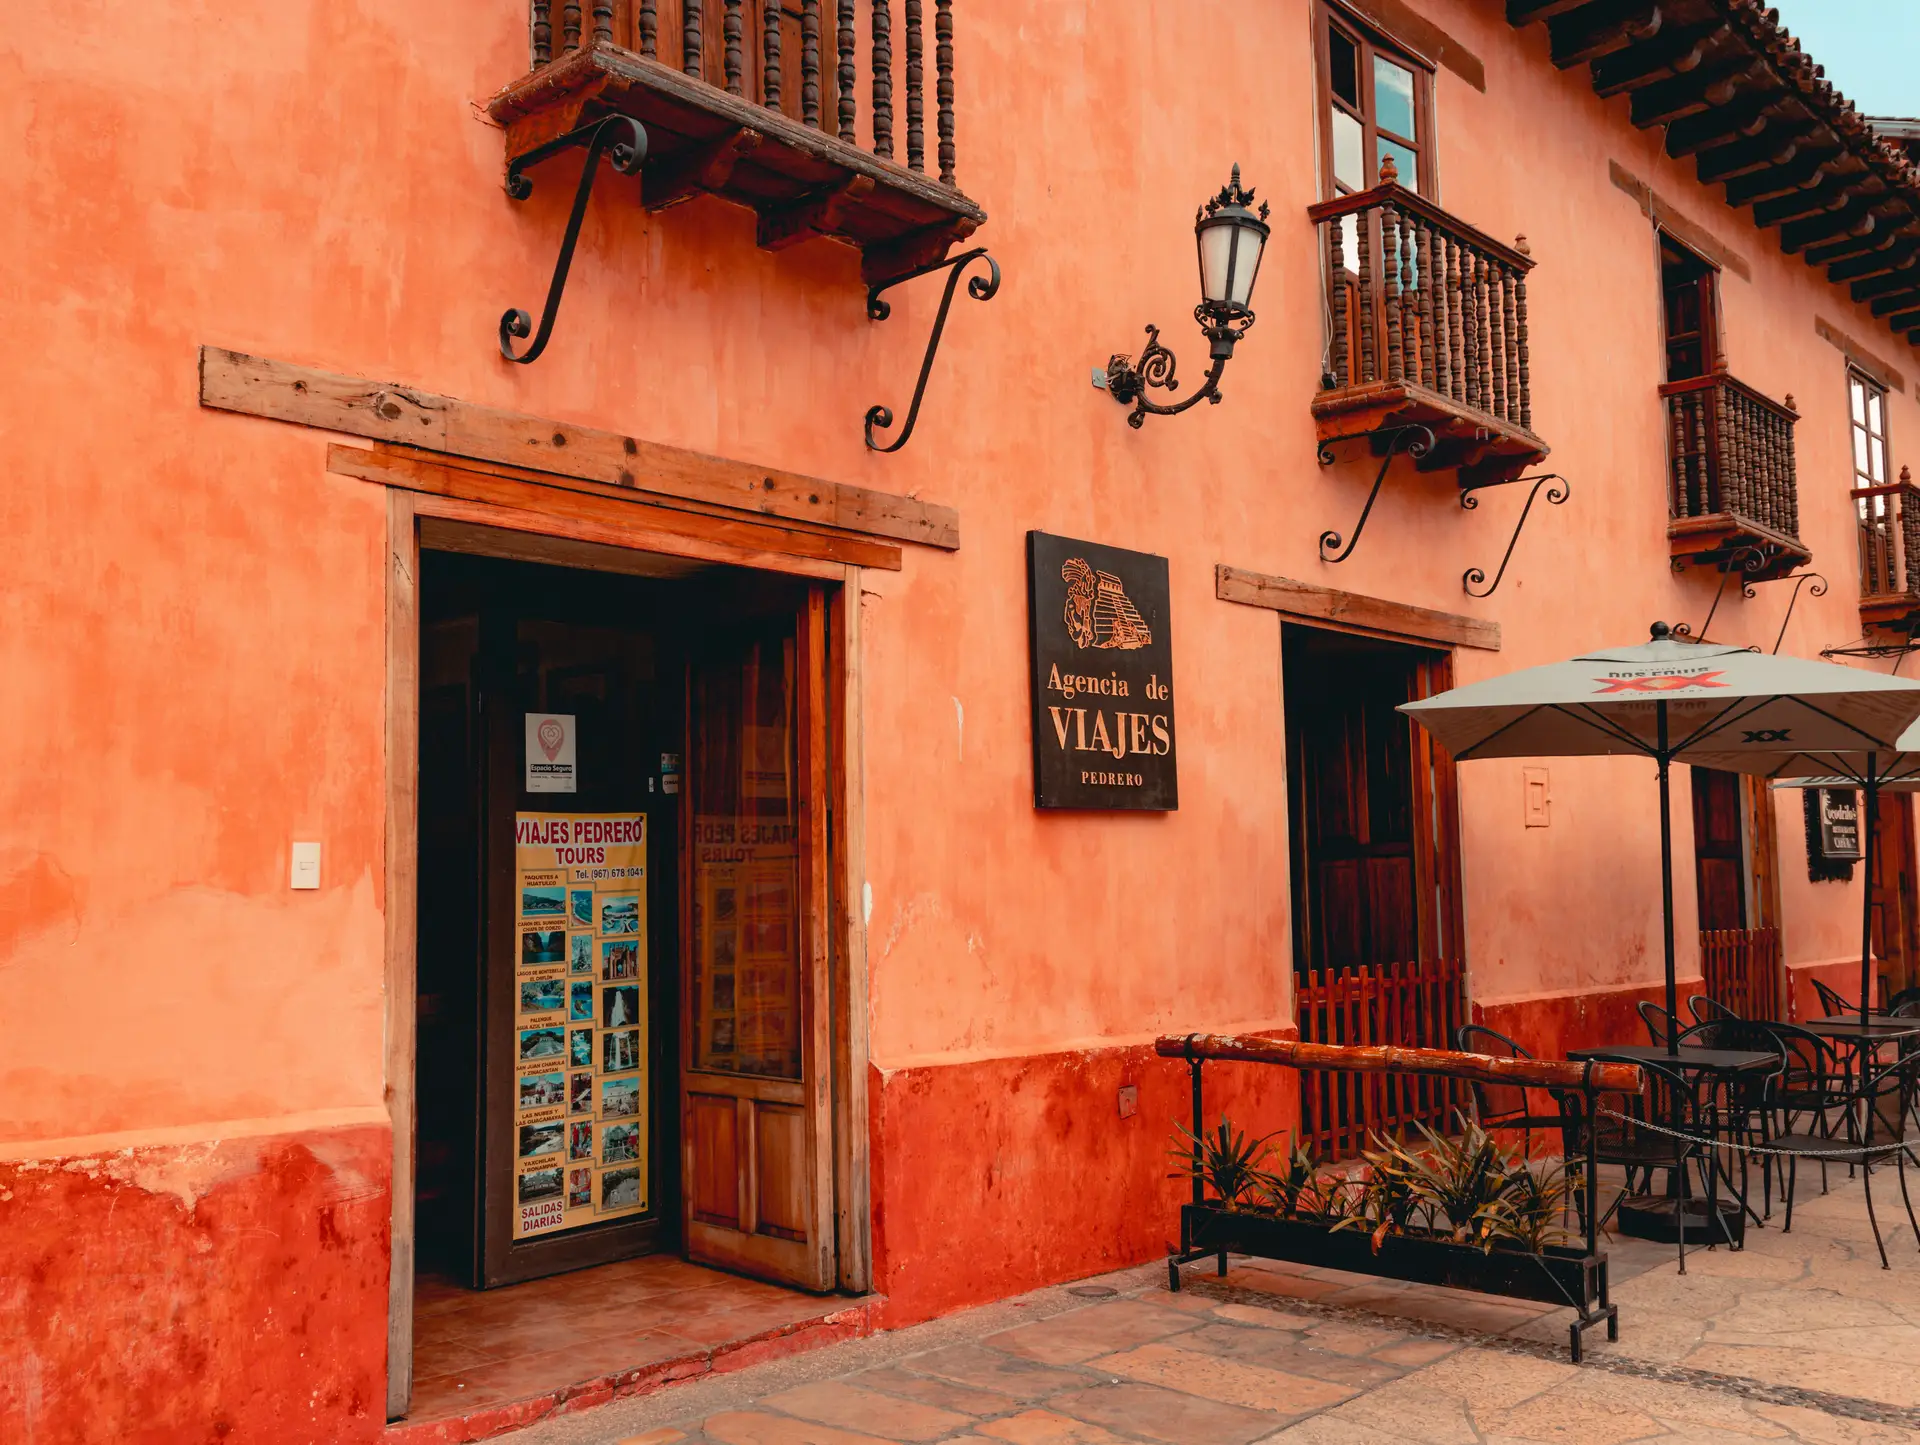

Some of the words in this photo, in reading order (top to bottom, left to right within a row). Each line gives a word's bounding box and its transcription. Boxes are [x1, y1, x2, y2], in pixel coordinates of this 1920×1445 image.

[1047, 662, 1130, 700] Agencia
[1145, 674, 1169, 701] de
[1047, 705, 1170, 760] VIAJES
[1740, 728, 1796, 743] XX
[530, 764, 552, 773] Espacio
[552, 764, 572, 773] Seguro
[1081, 771, 1143, 787] PEDRERO
[515, 821, 569, 844] VIAJES
[574, 820, 642, 844] PEDRERO
[555, 847, 605, 864] TOURS
[575, 869, 589, 879] Tel.
[591, 869, 610, 880] (967)
[611, 868, 625, 878] 678
[626, 867, 644, 877] 1041
[533, 1109, 553, 1117] NUBES
[523, 1156, 556, 1167] YAXCHILAN
[526, 1162, 558, 1173] BONAMPAK
[521, 1201, 563, 1219] SALIDAS
[523, 1213, 563, 1232] DIARIAS
